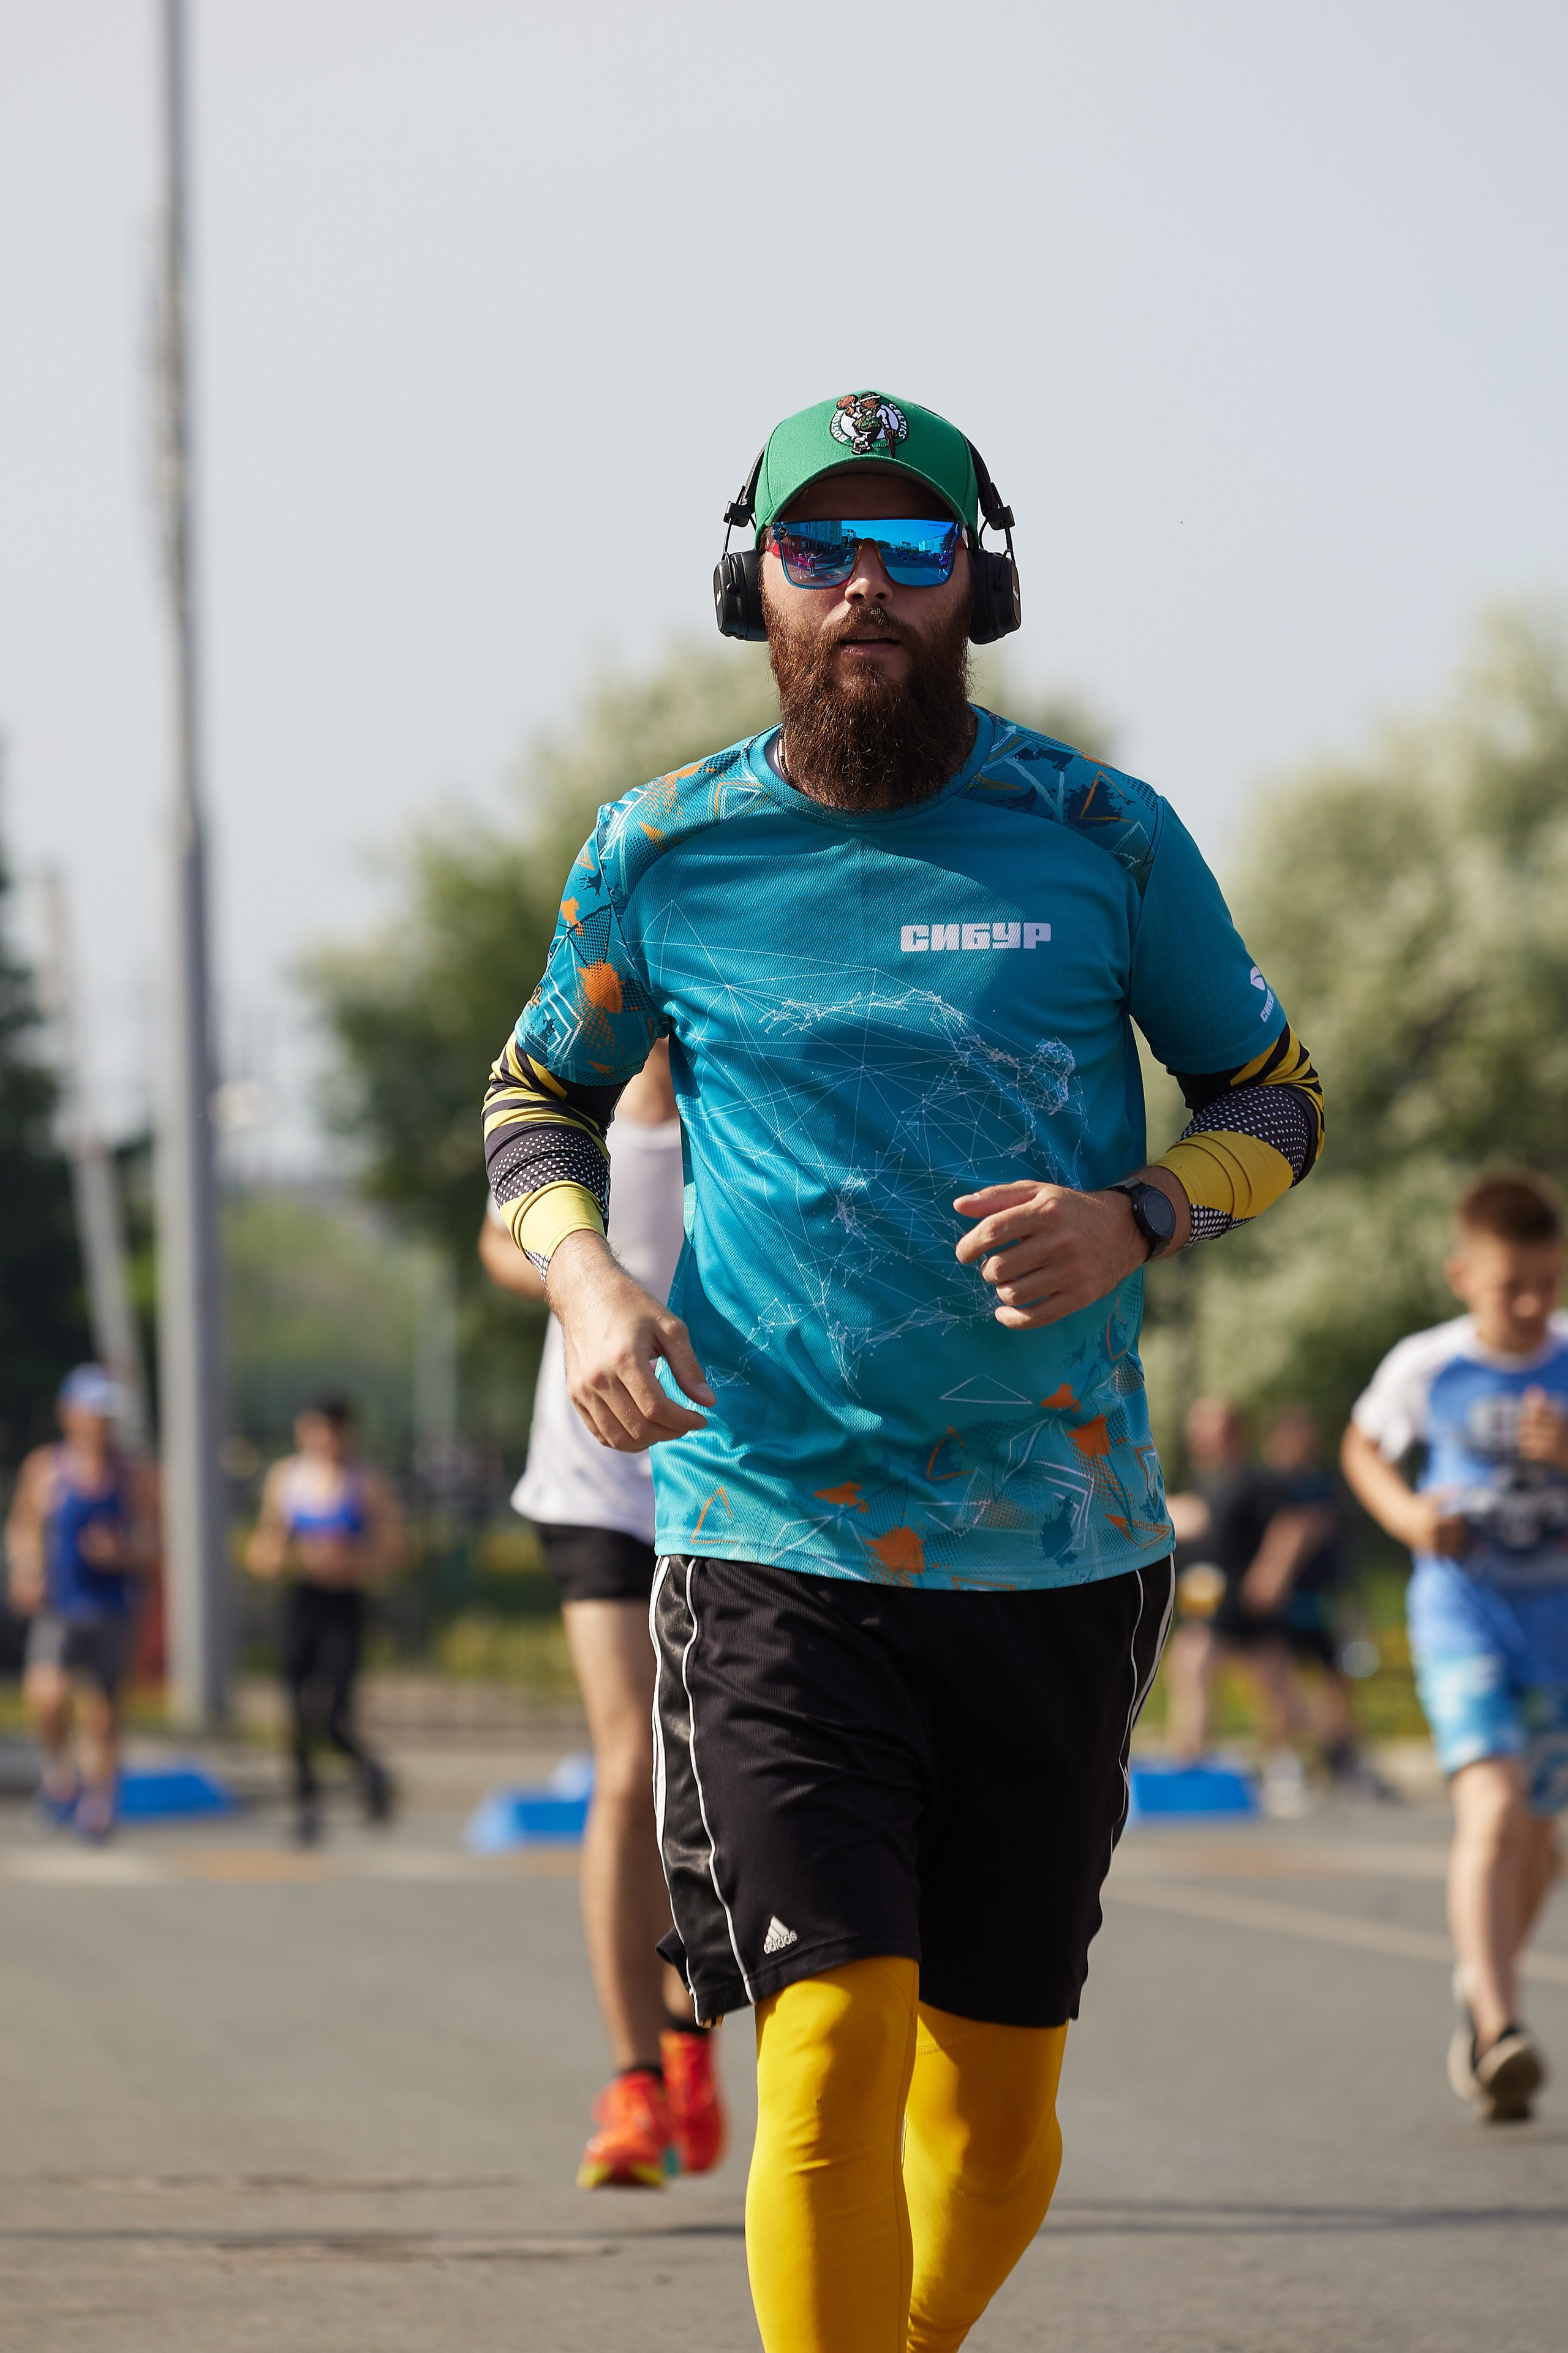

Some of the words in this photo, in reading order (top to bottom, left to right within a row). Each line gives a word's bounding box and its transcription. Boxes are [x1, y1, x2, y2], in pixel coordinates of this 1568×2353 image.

[889, 403, 907, 440] CELTICS
[900, 922, 1052, 952] СИБУР
[763, 1930, 797, 1954] adidas
